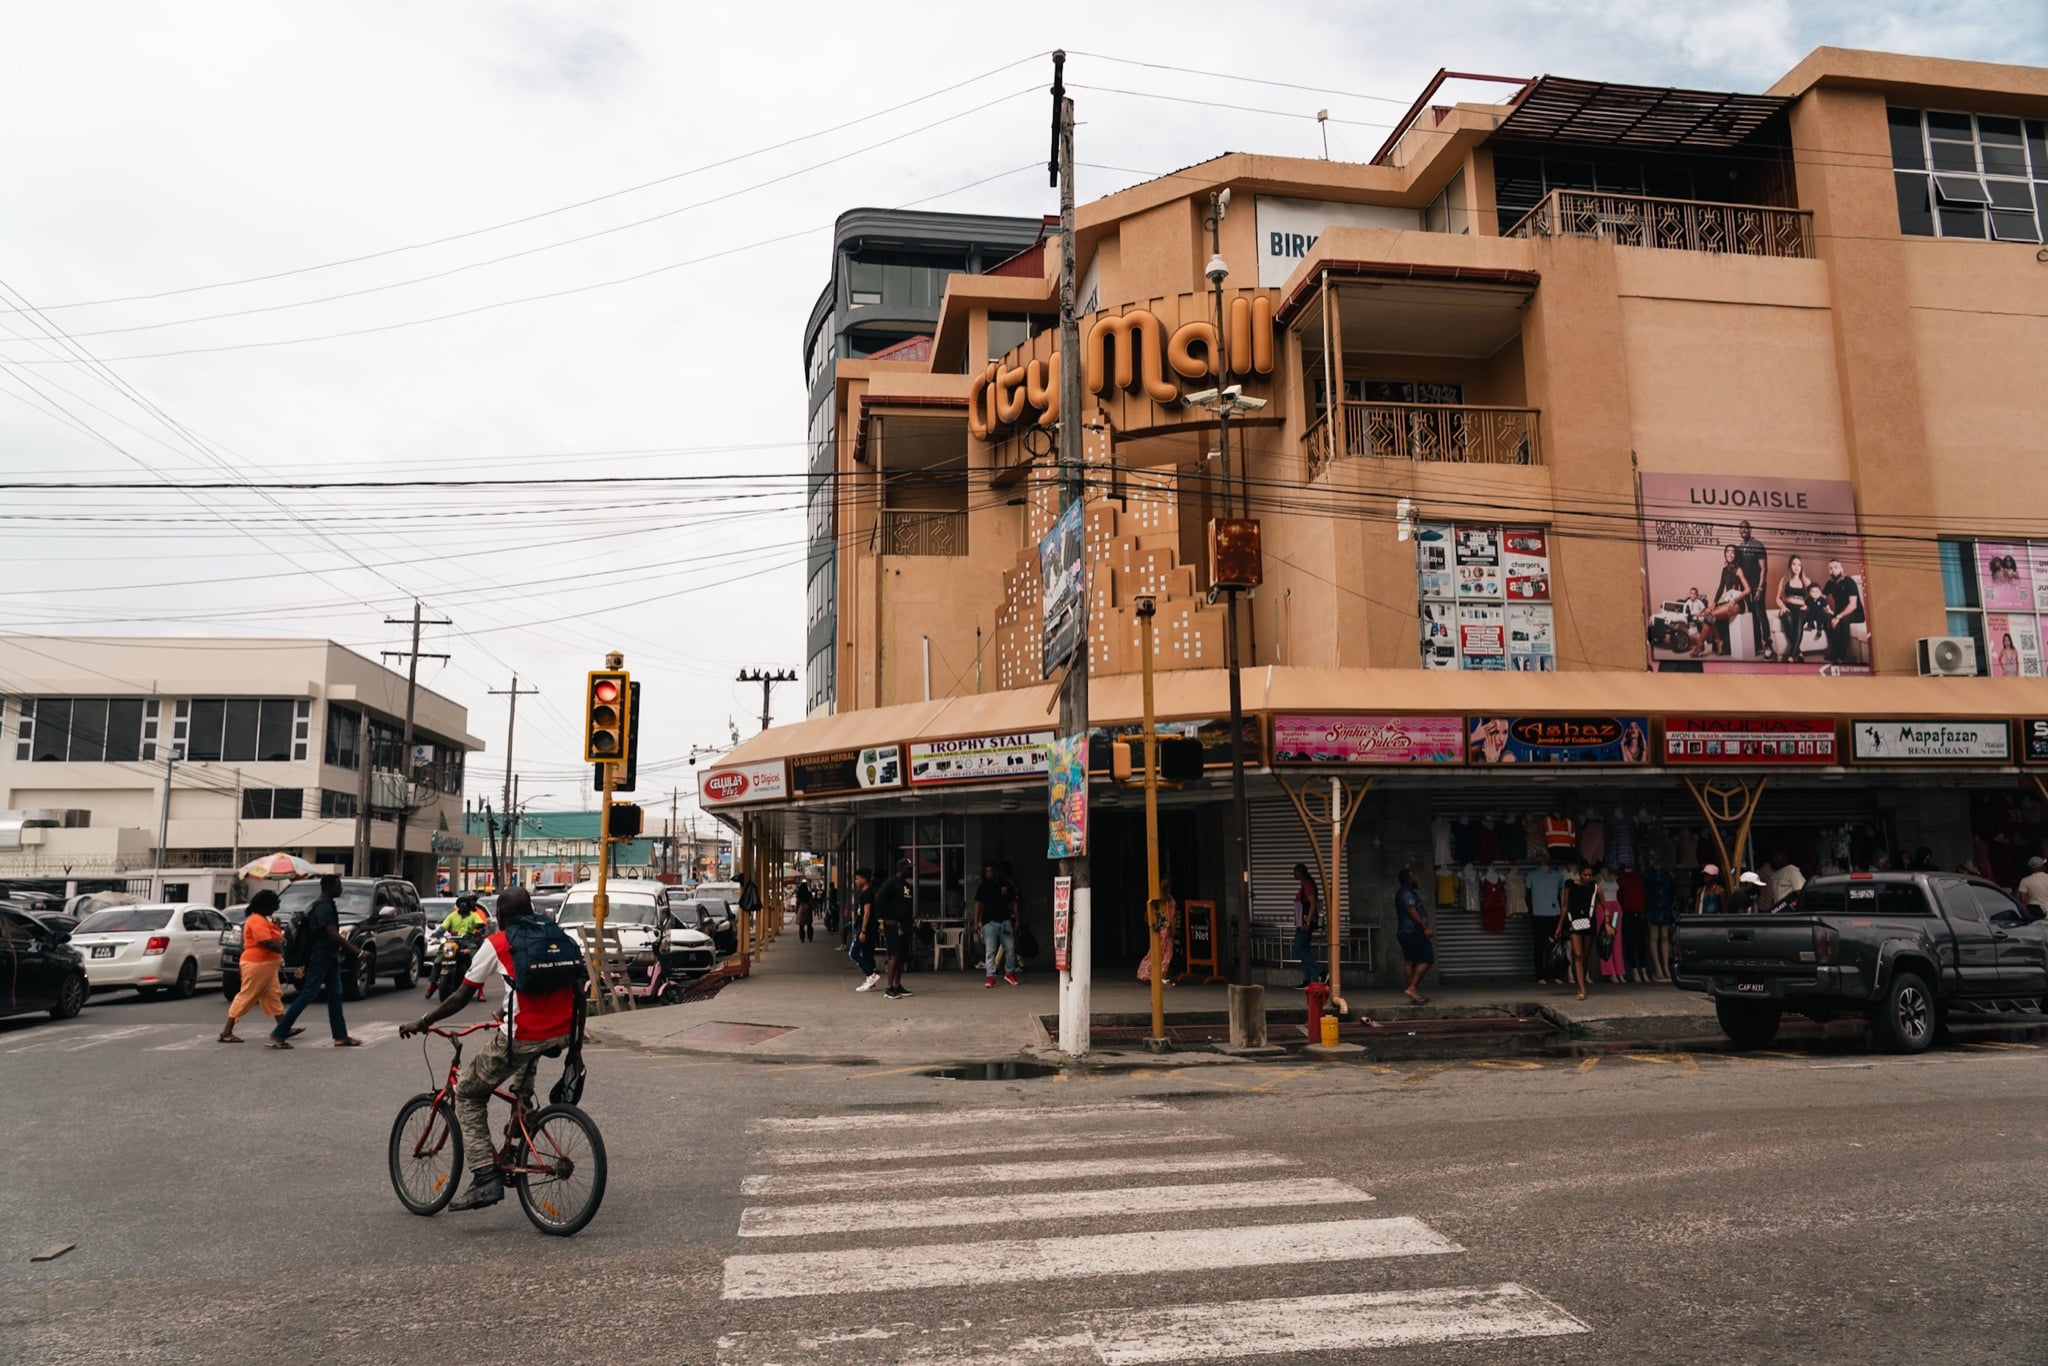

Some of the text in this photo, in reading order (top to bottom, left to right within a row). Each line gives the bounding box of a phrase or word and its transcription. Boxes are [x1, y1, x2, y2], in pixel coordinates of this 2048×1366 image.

[1690, 488, 1809, 509] LUJOAISLE
[1656, 528, 1676, 536] WHO
[1678, 529, 1702, 537] WALK
[1511, 561, 1541, 569] chargers
[1325, 722, 1379, 742] Sophie's
[1518, 722, 1616, 739] Ashaz
[1687, 719, 1813, 732] NAUDIA'S
[929, 734, 1034, 753] TROPHY STALL
[1358, 735, 1411, 751] Dulces
[1899, 727, 1978, 747] Mapafazan
[831, 751, 855, 763] HERBAL
[1908, 747, 1971, 755] RESTAURANT
[761, 772, 781, 785] Digicel
